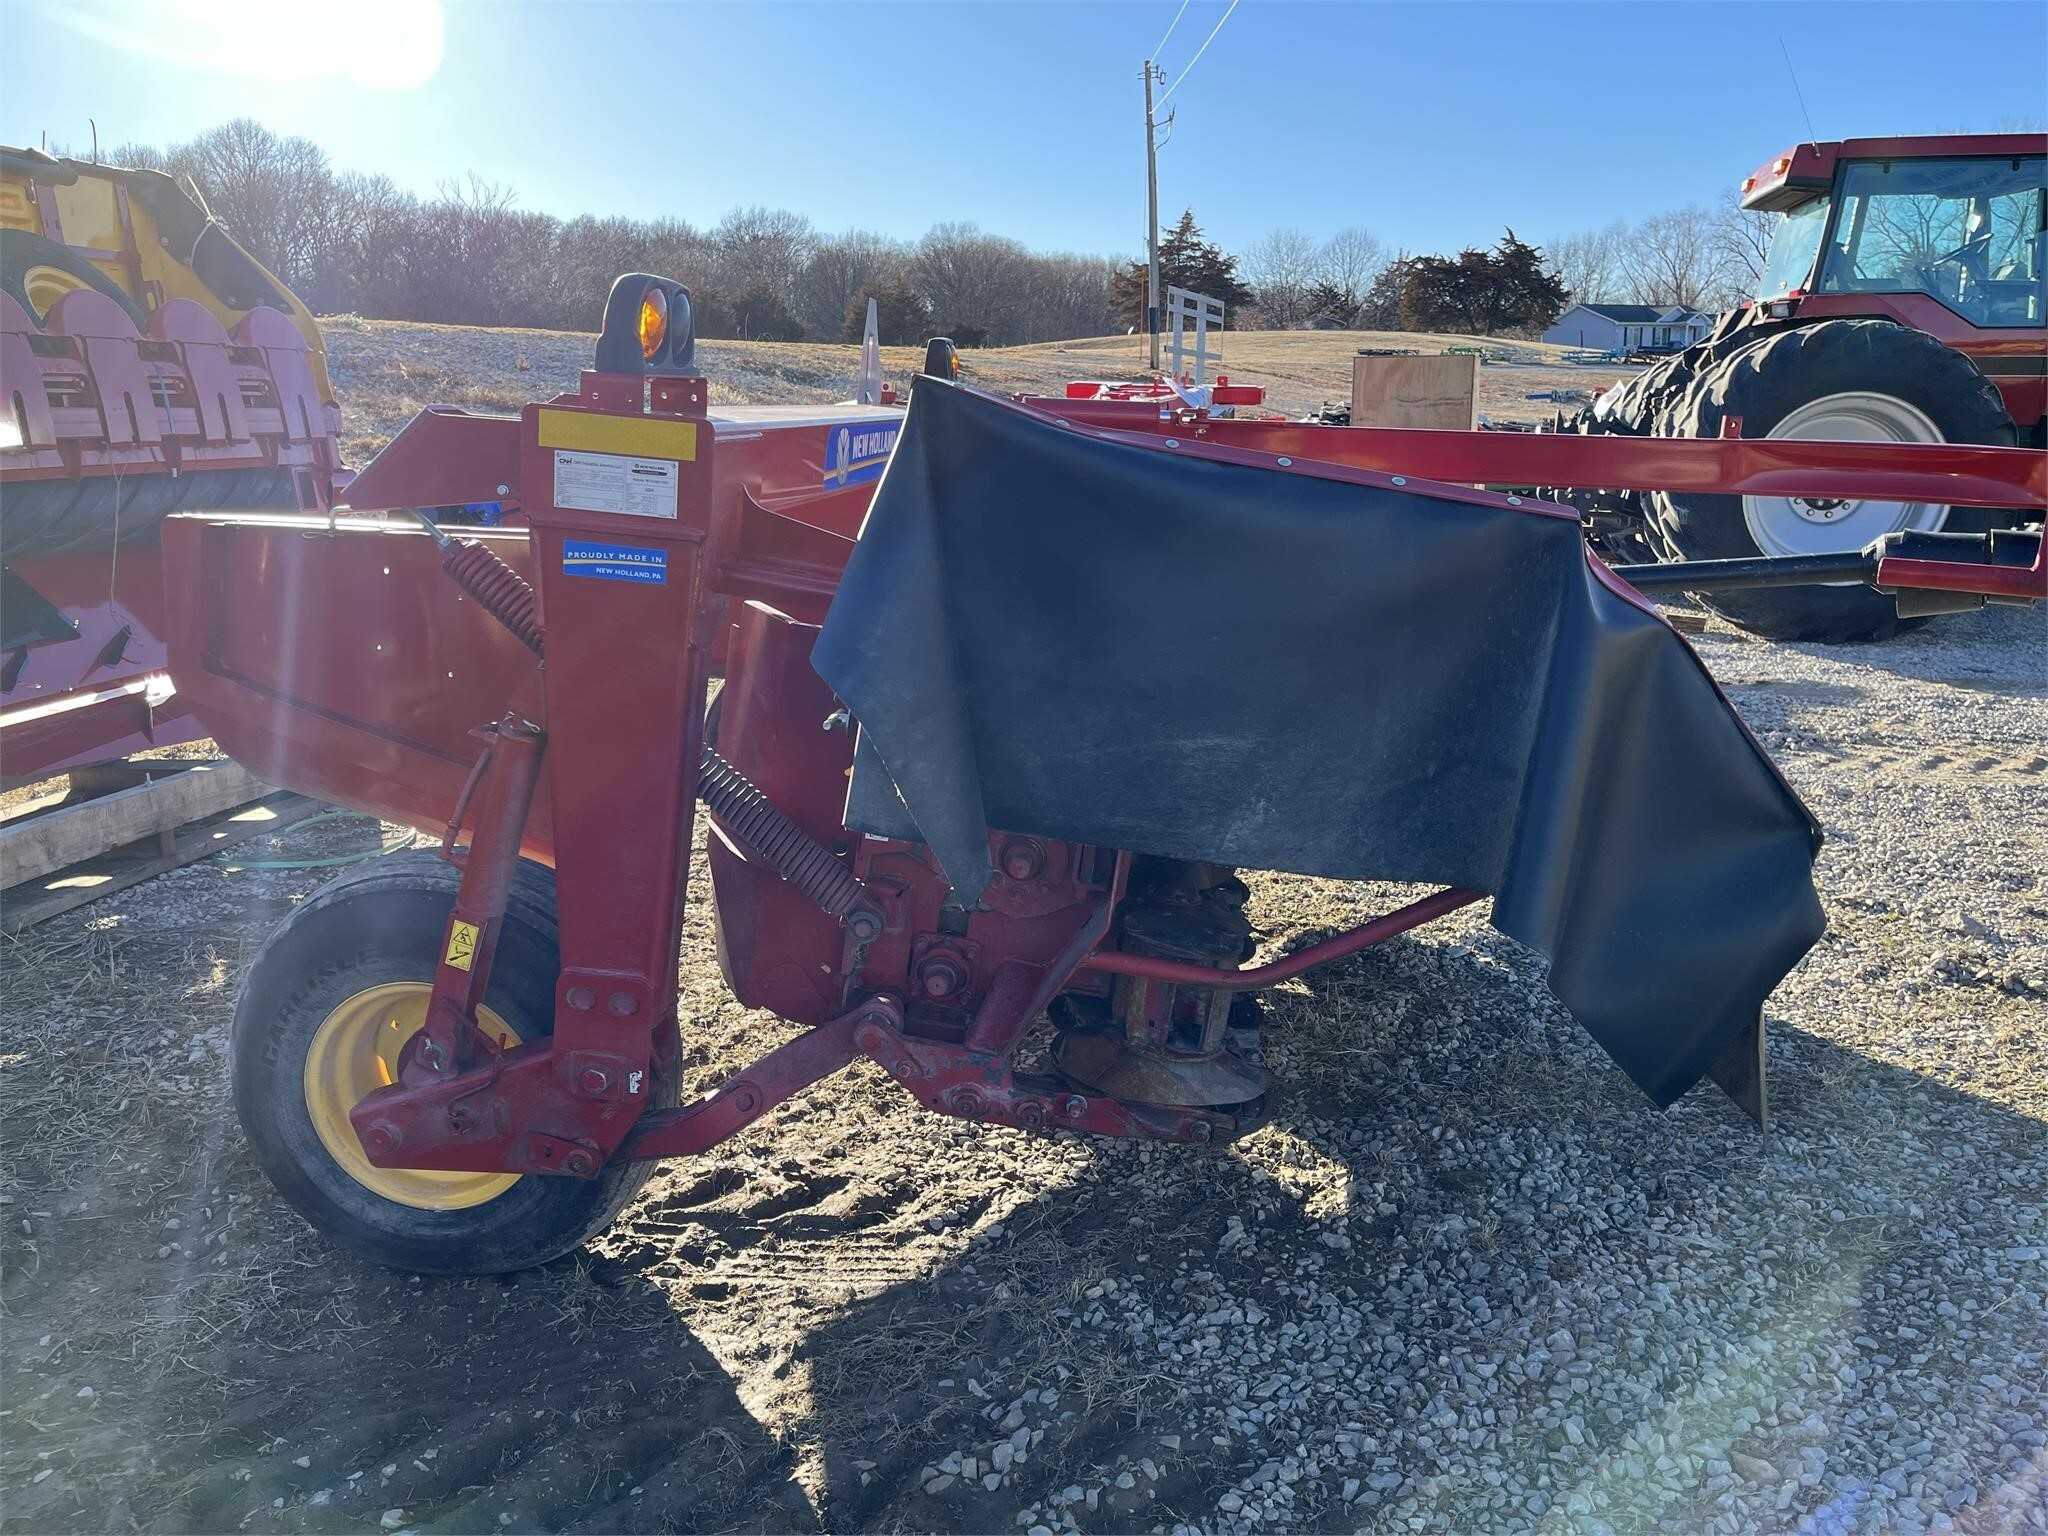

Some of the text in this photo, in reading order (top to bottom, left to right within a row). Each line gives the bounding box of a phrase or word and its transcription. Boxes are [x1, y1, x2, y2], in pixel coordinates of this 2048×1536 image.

[853, 430, 896, 460] NEW HOLLAND
[567, 551, 615, 559] PROUDLY
[618, 553, 647, 562] MADE
[596, 567, 613, 575] NEW
